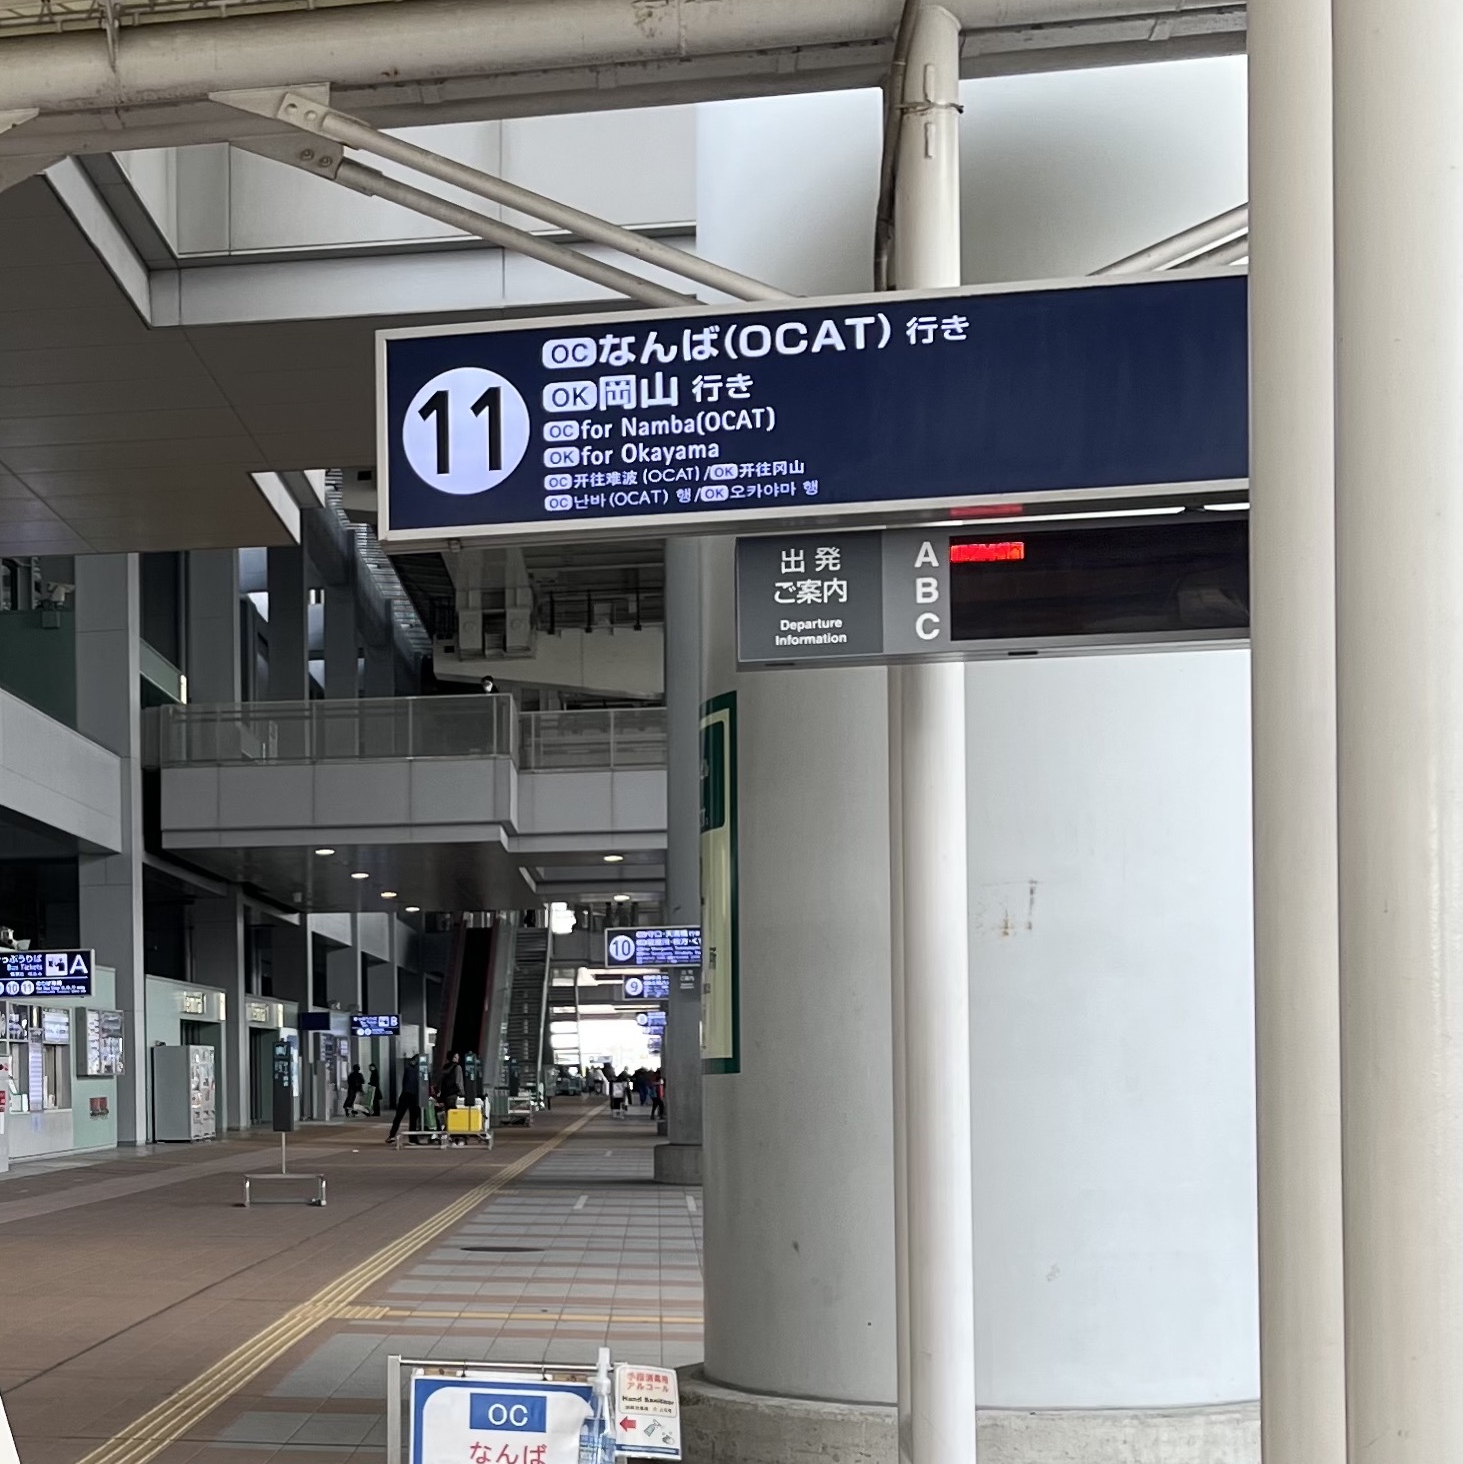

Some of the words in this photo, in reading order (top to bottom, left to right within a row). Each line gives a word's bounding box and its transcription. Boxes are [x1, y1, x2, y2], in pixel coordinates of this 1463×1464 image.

[598, 313, 892, 367] なんば(OCAT)
[906, 314, 970, 345] 行き
[599, 371, 679, 412] 岡山
[692, 372, 754, 403] 行き
[417, 386, 503, 475] 11
[581, 419, 613, 440] for
[621, 406, 776, 438] Namba(OCAT)
[581, 445, 613, 466] for
[621, 442, 720, 466] Okayama
[914, 541, 939, 568] A
[773, 577, 848, 604] ご案内
[915, 577, 939, 604] B
[780, 617, 843, 632] Departure
[915, 612, 940, 640] C
[775, 632, 847, 646] Information
[612, 940, 631, 957] 10
[69, 954, 88, 974] A
[488, 1402, 529, 1427] OC
